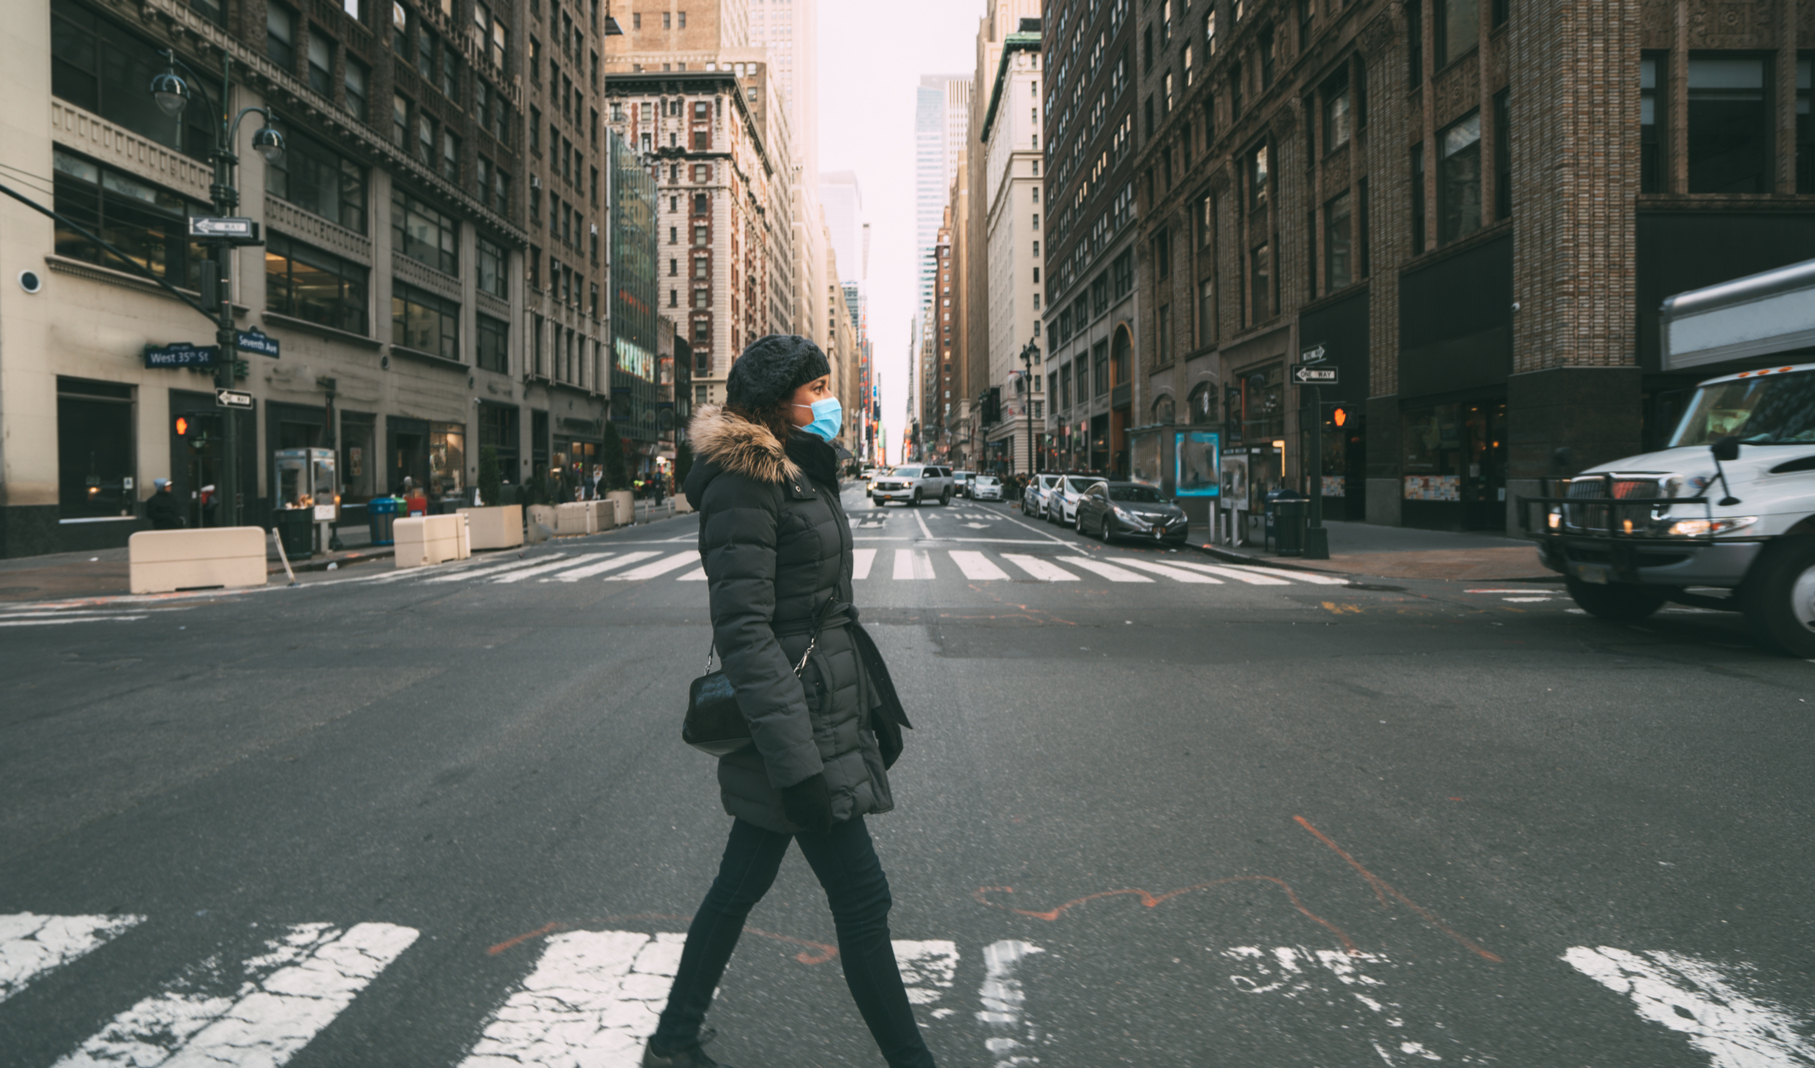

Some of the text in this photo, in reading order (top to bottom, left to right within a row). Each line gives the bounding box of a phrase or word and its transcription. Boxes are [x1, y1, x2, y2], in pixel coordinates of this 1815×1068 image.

[224, 223, 241, 231] WAY
[239, 335, 265, 350] Seventh
[265, 343, 278, 354] Ave
[150, 351, 209, 364] West 35th St
[1300, 370, 1312, 378] ONE
